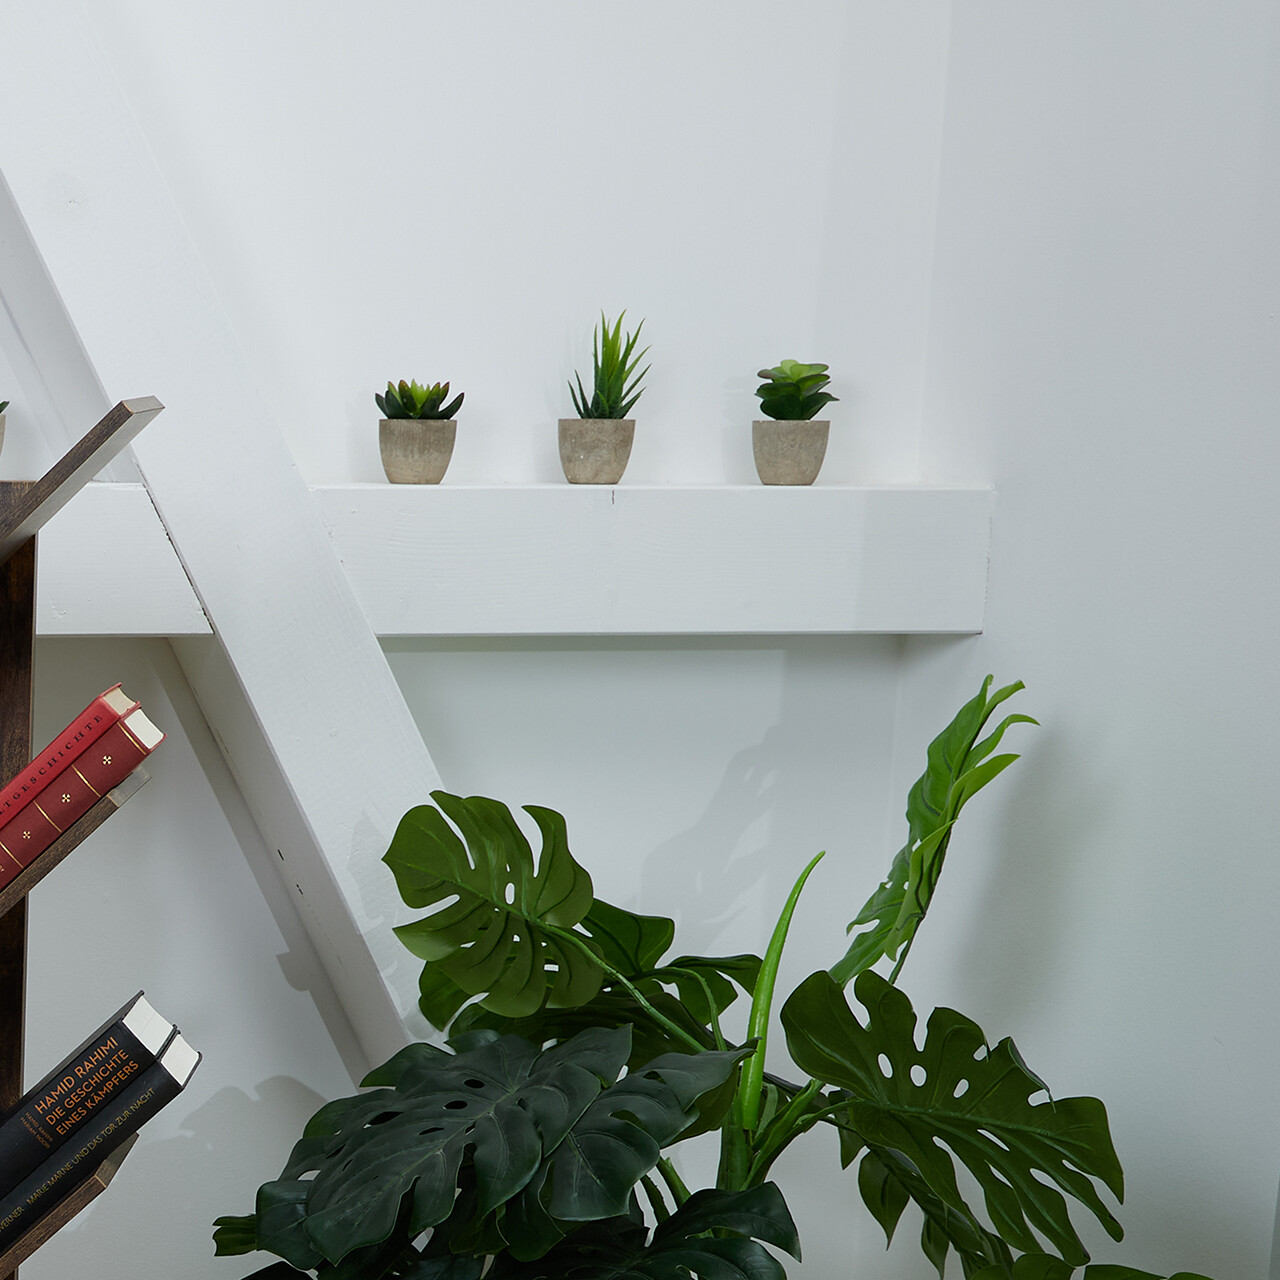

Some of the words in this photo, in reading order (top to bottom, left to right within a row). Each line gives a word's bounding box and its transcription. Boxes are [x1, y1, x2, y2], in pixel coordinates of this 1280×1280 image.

[35, 1076, 75, 1114] HAMID
[76, 1036, 119, 1078] RAHIMI
[45, 1105, 67, 1126] DIE
[64, 1050, 129, 1110] GESCHICHTE
[56, 1107, 87, 1136] EINES
[86, 1060, 139, 1110] KÄMPFERS
[27, 1182, 51, 1205] MARIE
[71, 1147, 90, 1166] UND
[88, 1135, 103, 1151] DAS
[100, 1122, 118, 1138] TOR
[114, 1110, 132, 1126] ZUR
[129, 1087, 156, 1115] NACHT
